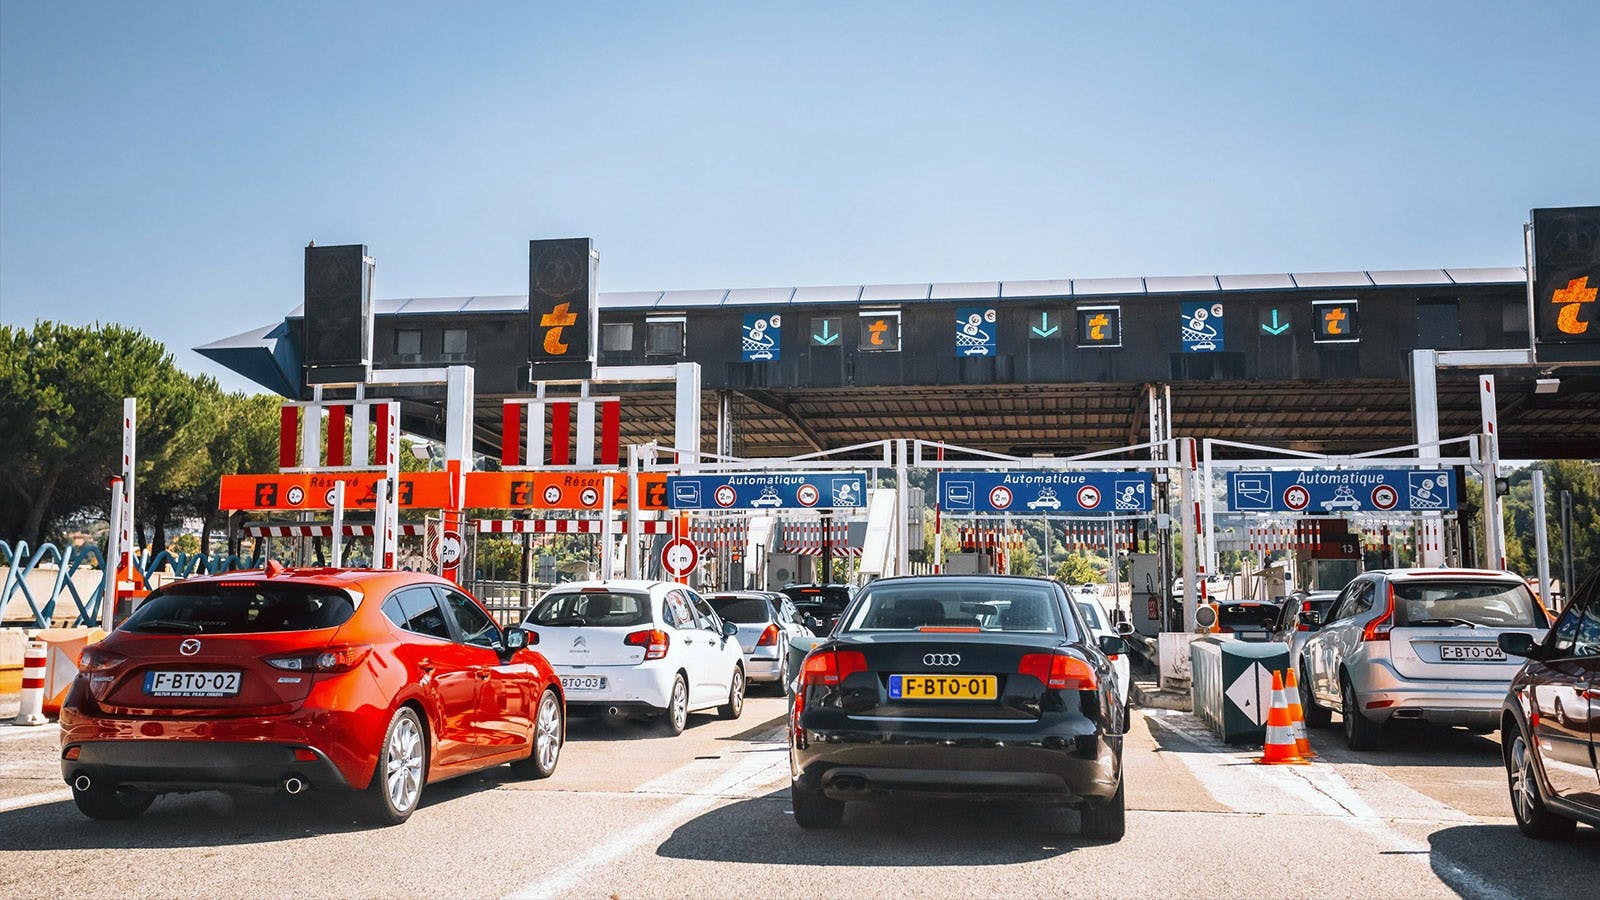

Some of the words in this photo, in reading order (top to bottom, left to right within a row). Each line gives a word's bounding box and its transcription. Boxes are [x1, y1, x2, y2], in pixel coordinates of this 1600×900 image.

[311, 476, 359, 487] Résvé
[564, 475, 604, 487] Réser
[728, 475, 805, 485] Automatique
[1003, 474, 1086, 485] Automatique
[1296, 471, 1384, 486] Automatique
[1342, 544, 1353, 553] 13
[155, 673, 236, 690] F-BTO-02
[906, 679, 988, 695] F-BTO-01
